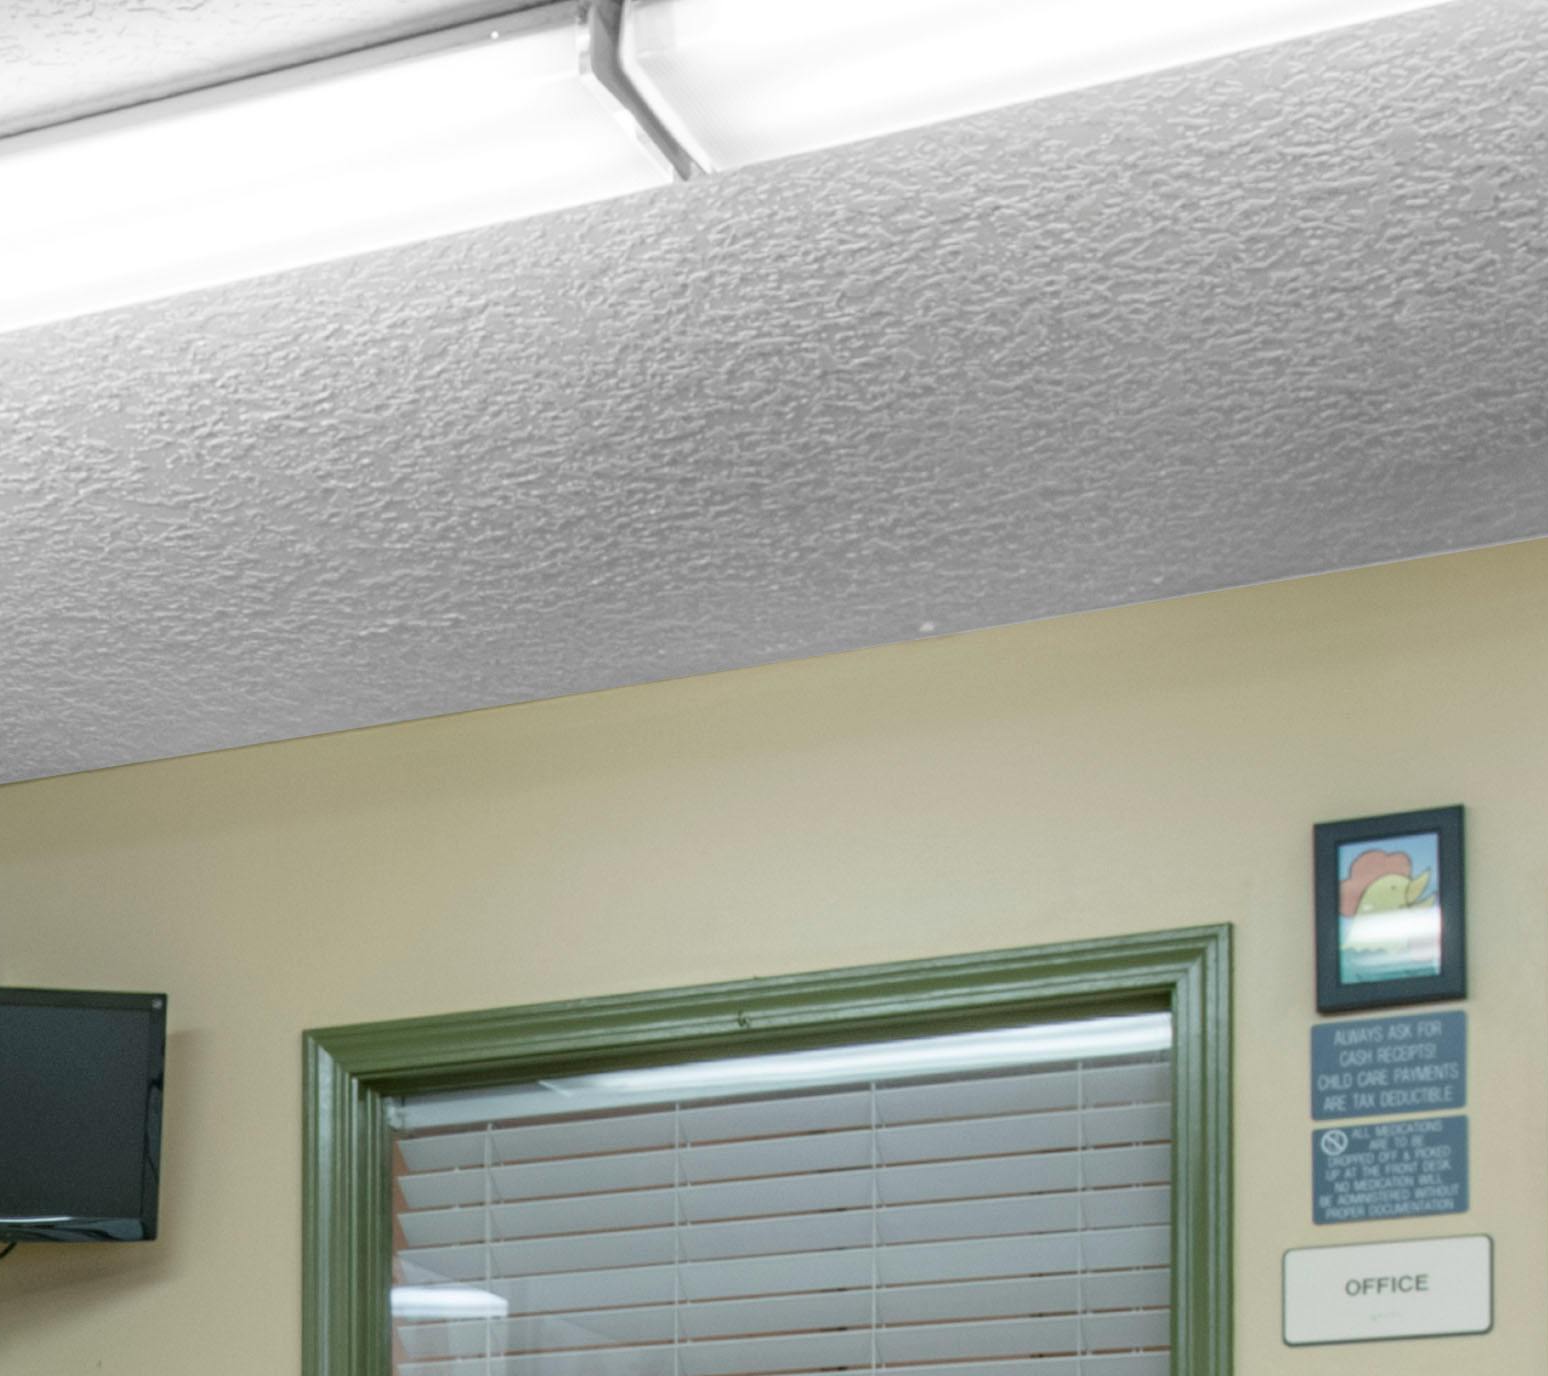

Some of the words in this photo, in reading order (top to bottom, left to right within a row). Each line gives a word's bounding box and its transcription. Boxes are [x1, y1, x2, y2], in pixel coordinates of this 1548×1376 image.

[1334, 1025, 1383, 1046] ALWAYS
[1388, 1023, 1412, 1040] ASK
[1417, 1020, 1442, 1038] FOR
[1339, 1049, 1373, 1067] CASH
[1317, 1072, 1352, 1091] CHILD
[1357, 1068, 1389, 1087] CARE
[1393, 1062, 1459, 1083] PAYMENTS
[1323, 1094, 1347, 1111] ARE
[1352, 1092, 1375, 1109] TAX
[1379, 1085, 1453, 1107] DEDUCTIBLE
[1344, 1274, 1430, 1297] OFFICE
